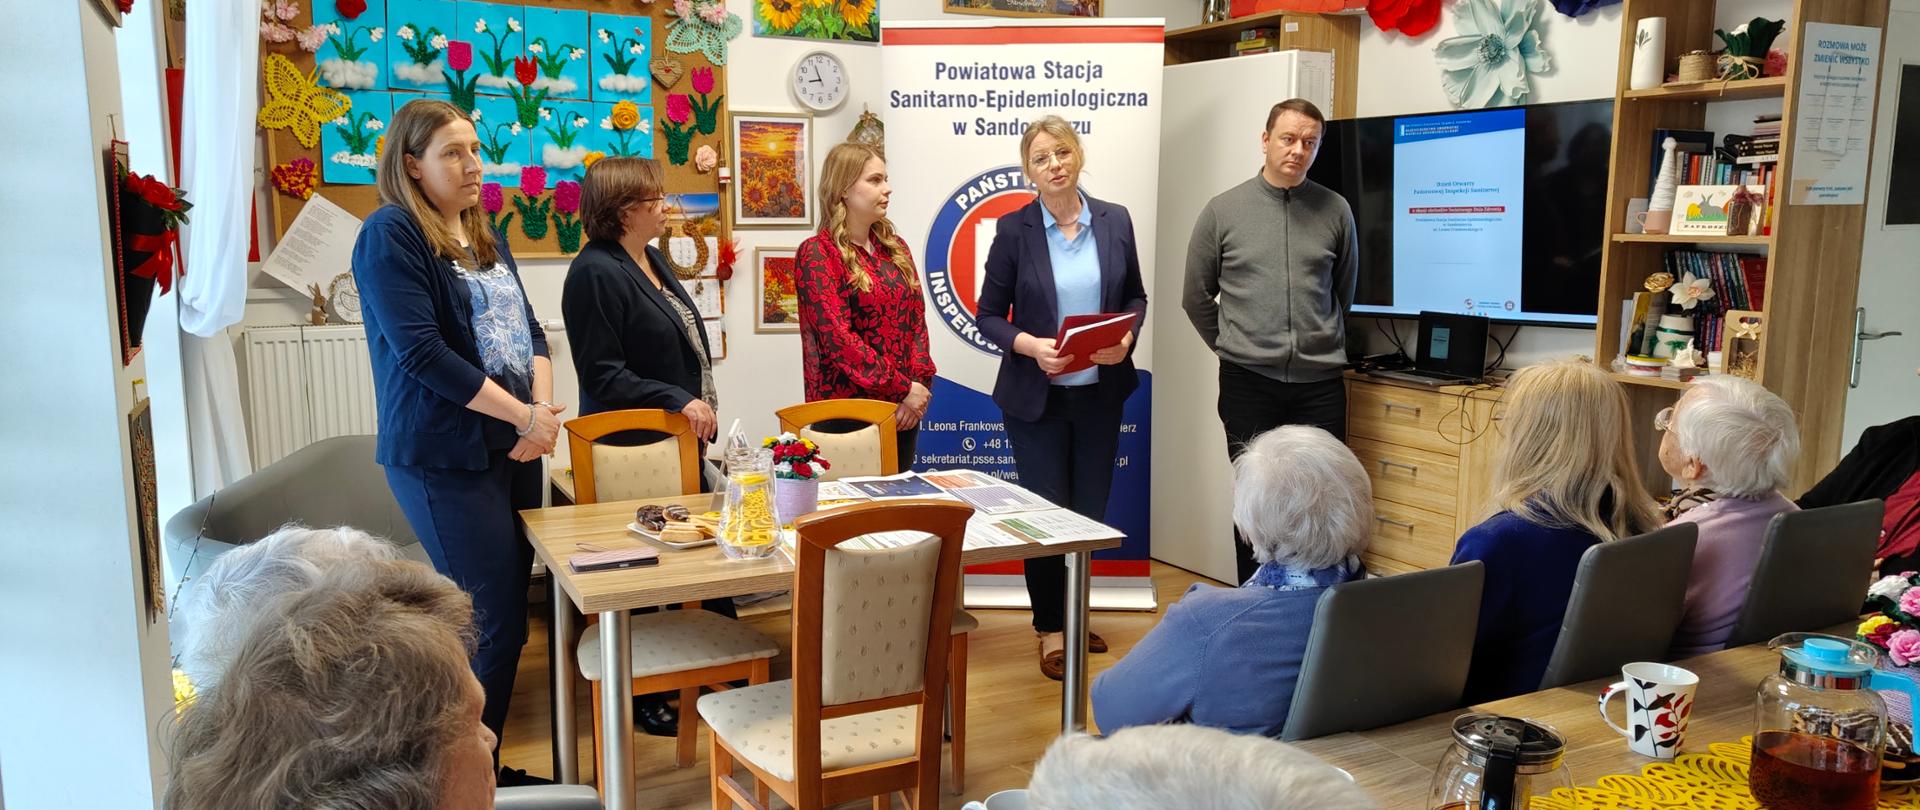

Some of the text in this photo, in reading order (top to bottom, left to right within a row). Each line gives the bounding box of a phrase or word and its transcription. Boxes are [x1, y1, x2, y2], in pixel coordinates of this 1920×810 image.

[935, 60, 1103, 82] Powiatowa Stacja
[890, 89, 1148, 111] Sanitarno-Epidemiologiczna
[953, 117, 1091, 136] w Sandozu
[930, 271, 1004, 353] INSPEKC
[928, 421, 957, 431] Leona
[959, 420, 1005, 431] Frankows
[983, 438, 1000, 449] +48
[921, 453, 1016, 466] sekretariat.psse.san
